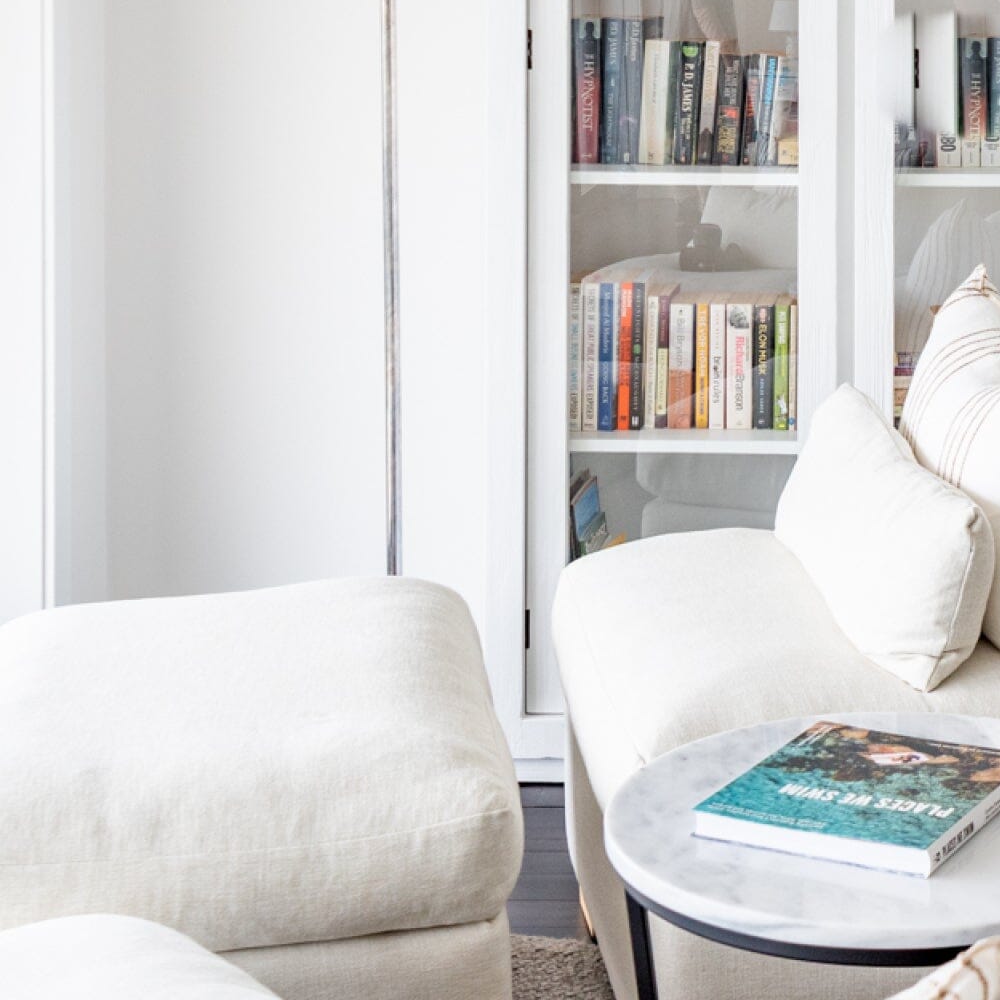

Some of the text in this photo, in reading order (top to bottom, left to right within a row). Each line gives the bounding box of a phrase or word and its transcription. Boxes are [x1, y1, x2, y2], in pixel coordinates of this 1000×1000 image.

[581, 61, 595, 131] HYPNOTIST
[681, 82, 694, 112] JAMES
[758, 324, 767, 349] ELON
[777, 783, 955, 818] PLACES WE SWIM
